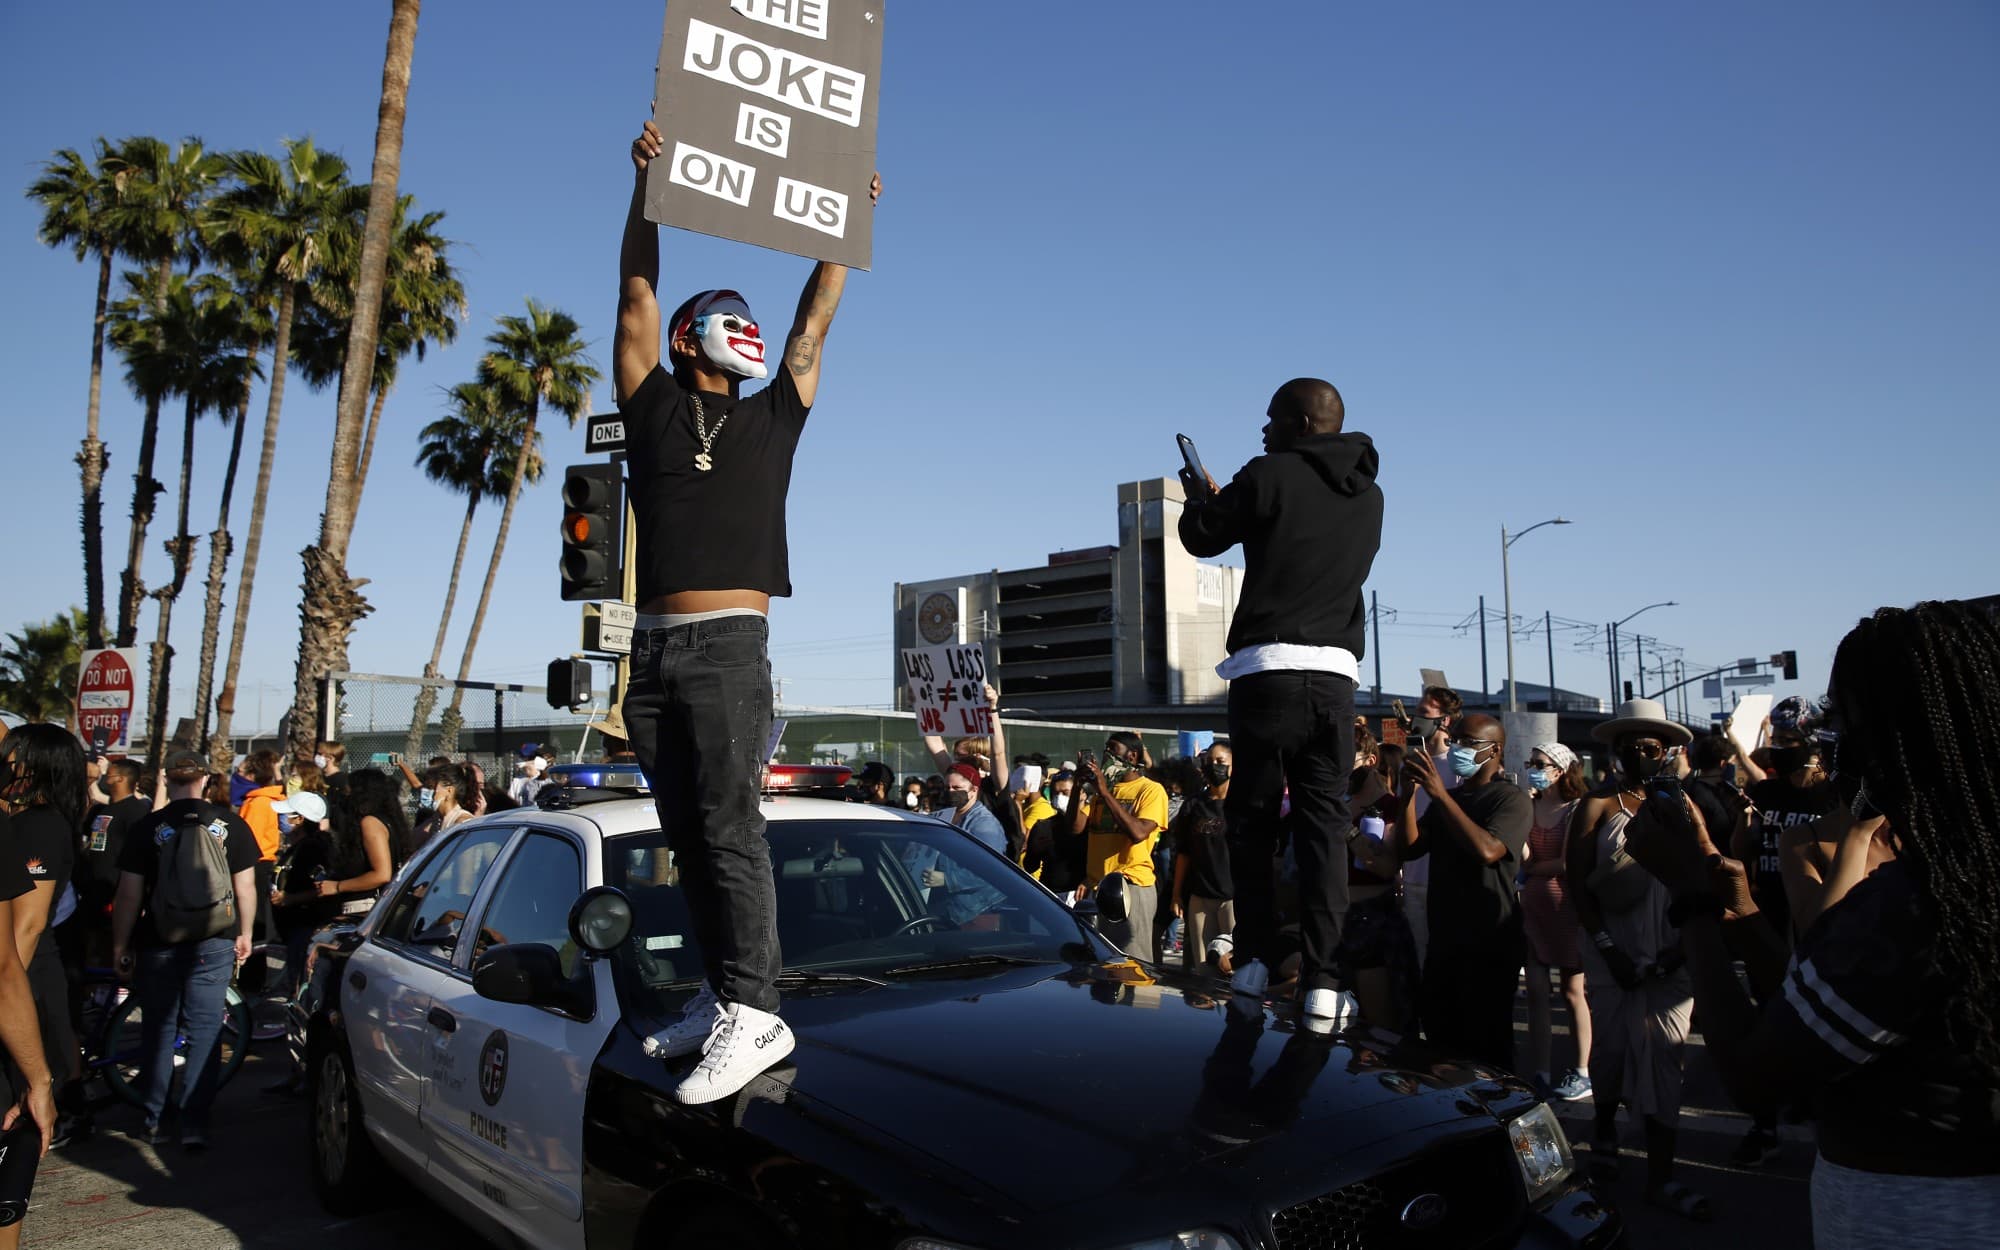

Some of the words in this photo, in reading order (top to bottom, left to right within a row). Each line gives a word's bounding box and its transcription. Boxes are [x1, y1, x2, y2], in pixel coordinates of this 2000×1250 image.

[692, 33, 856, 118] JOKE
[744, 111, 782, 148] IS
[680, 153, 746, 199] ON
[784, 184, 840, 227] US
[595, 424, 621, 441] ONE
[609, 609, 618, 619] NO
[86, 670, 101, 686] DO
[105, 669, 128, 686] NOT
[903, 652, 935, 682] LOSS
[946, 648, 985, 682] LOSS
[85, 715, 119, 730] ENTER
[920, 707, 945, 733] JOB
[960, 706, 995, 734] LIFE
[755, 1020, 785, 1049] CALVIN
[470, 1111, 507, 1150] POLICE
